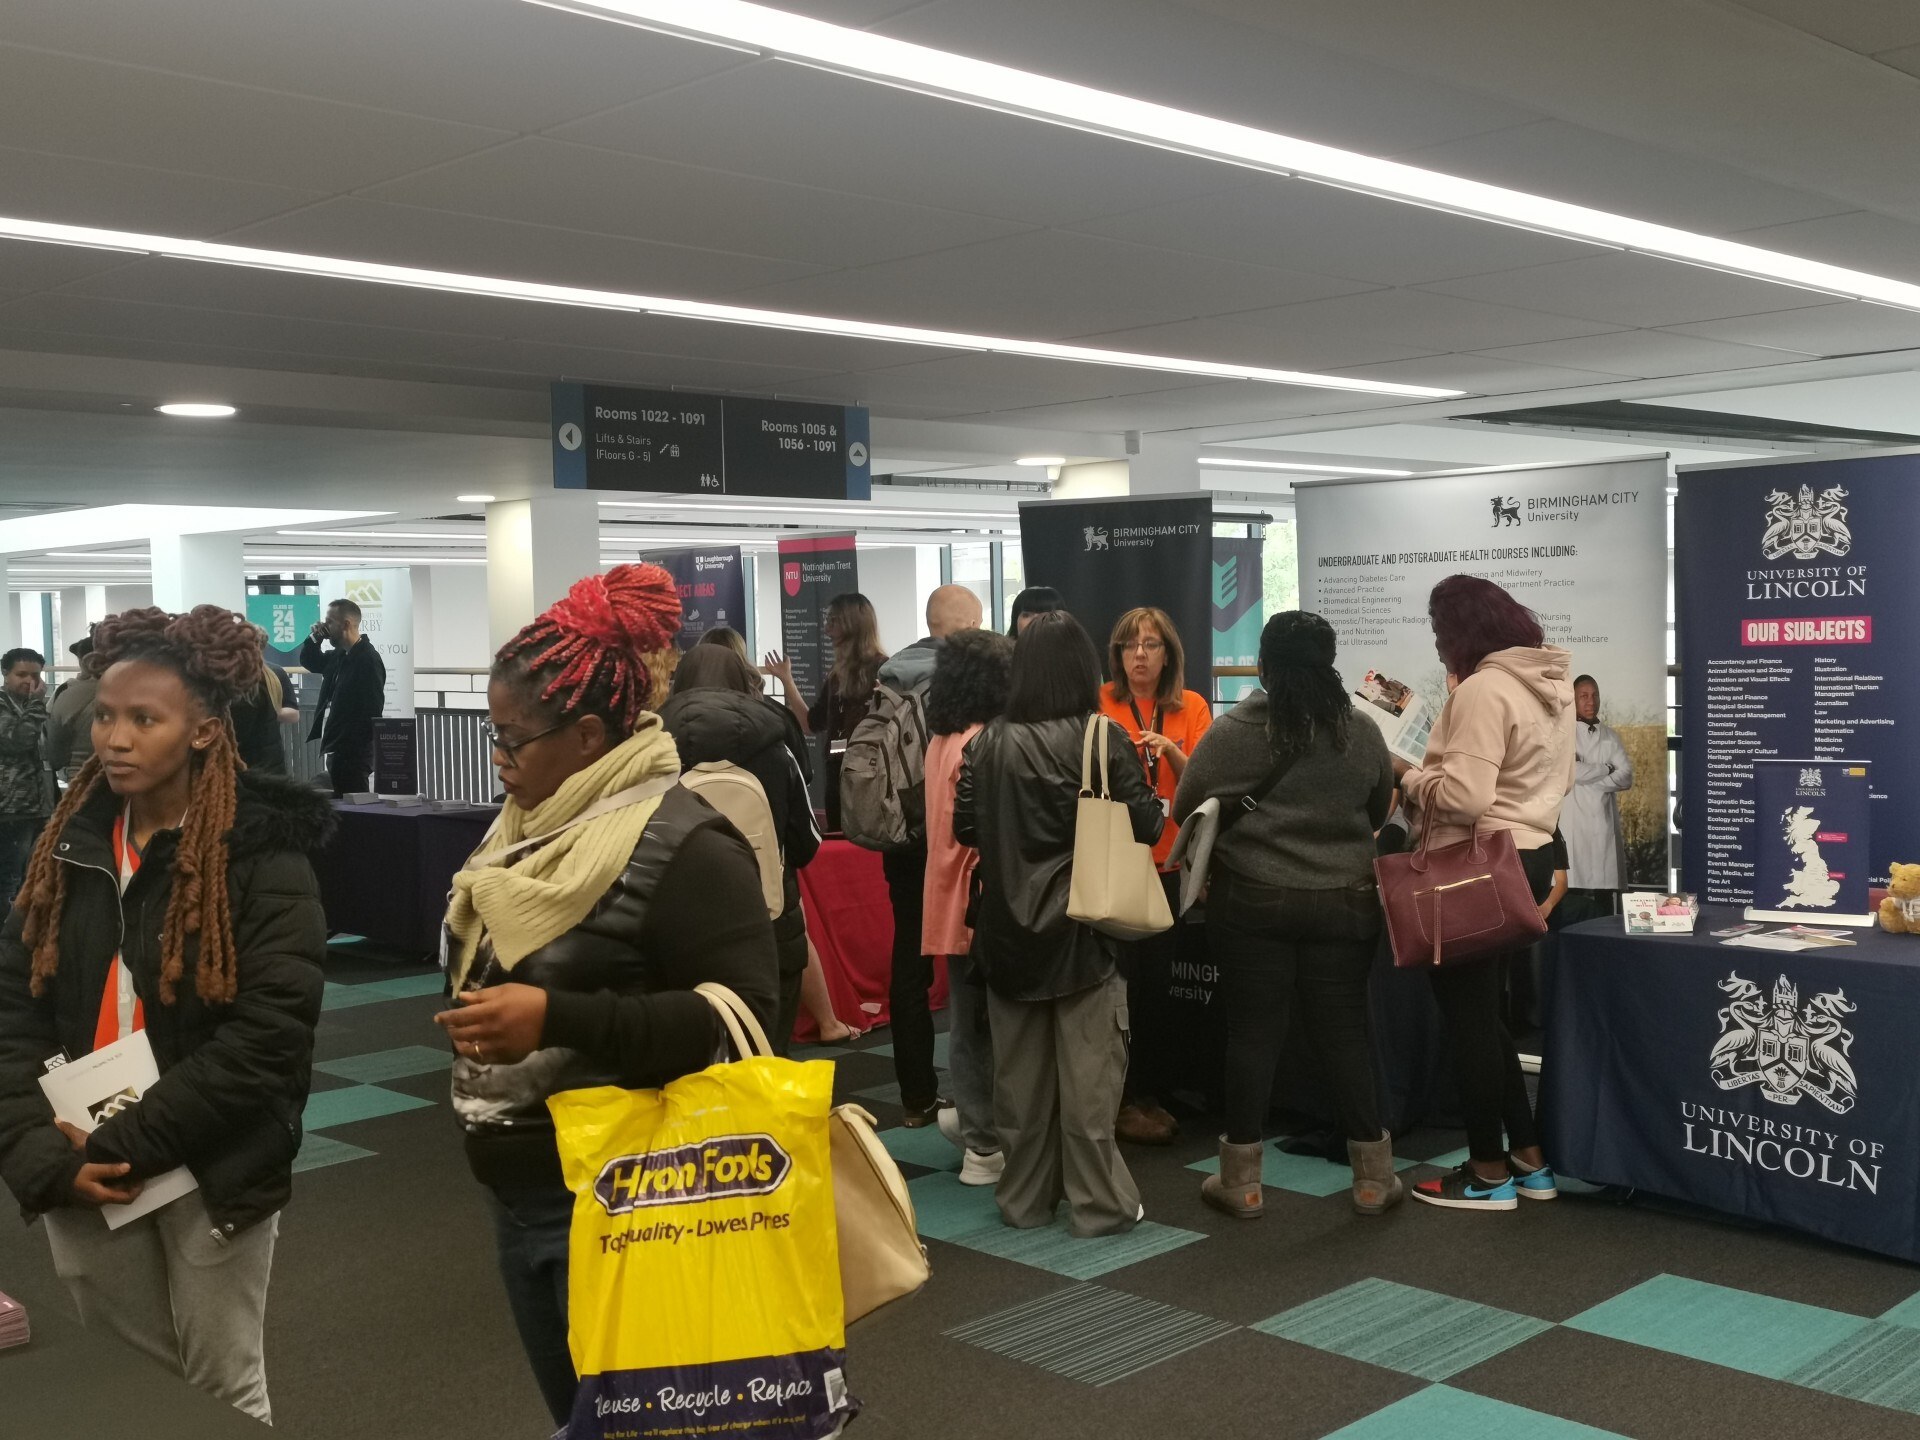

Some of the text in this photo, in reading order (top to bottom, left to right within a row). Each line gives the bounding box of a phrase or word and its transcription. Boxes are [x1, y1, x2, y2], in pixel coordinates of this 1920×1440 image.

[596, 406, 705, 425] Rooms 1022 1091
[762, 420, 836, 436] Rooms 1005 &
[596, 433, 651, 445] Lifts & Stairs
[779, 438, 836, 452] 1056 1091
[596, 449, 650, 462] (Floors G 5)
[1528, 492, 1638, 509] BIRMINGHAM CITY
[1528, 511, 1579, 522] University
[1114, 524, 1200, 537] BIRMINGHAM CITY
[1114, 538, 1154, 546] University
[704, 555, 733, 563] Loughborough
[1319, 545, 1578, 567] UNDERGRADUATE AND POSTGRADUATE HEALTH COURSES INCLUDING:
[803, 561, 851, 572] Nottingham Trent
[1747, 566, 1866, 580] UNIVERSITY OF
[803, 573, 831, 583] University
[1324, 576, 1357, 584] Advancing
[1498, 579, 1575, 589] Department Practice
[695, 583, 715, 597] AREAS
[1747, 579, 1866, 600] LINCOLN
[1362, 596, 1401, 605] Engineering
[273, 610, 294, 626] 24
[1541, 614, 1570, 622] Nursing
[274, 627, 295, 642] 25
[1543, 624, 1572, 633] Therapy
[1748, 620, 1865, 642] OUR SUBJECTS
[387, 644, 408, 654] YOU
[1351, 638, 1387, 646] Ultrasound
[1170, 985, 1212, 1005] versity
[1727, 1072, 1760, 1088] LIBERTAS
[1800, 1080, 1843, 1113] SAPIENTIAM
[1681, 1102, 1884, 1158] UNIVERSITY OF
[1683, 1122, 1881, 1195] LINCOLN
[612, 1162, 696, 1202] Hron
[697, 1216, 747, 1237] Lowes
[657, 1384, 731, 1416] Recycle
